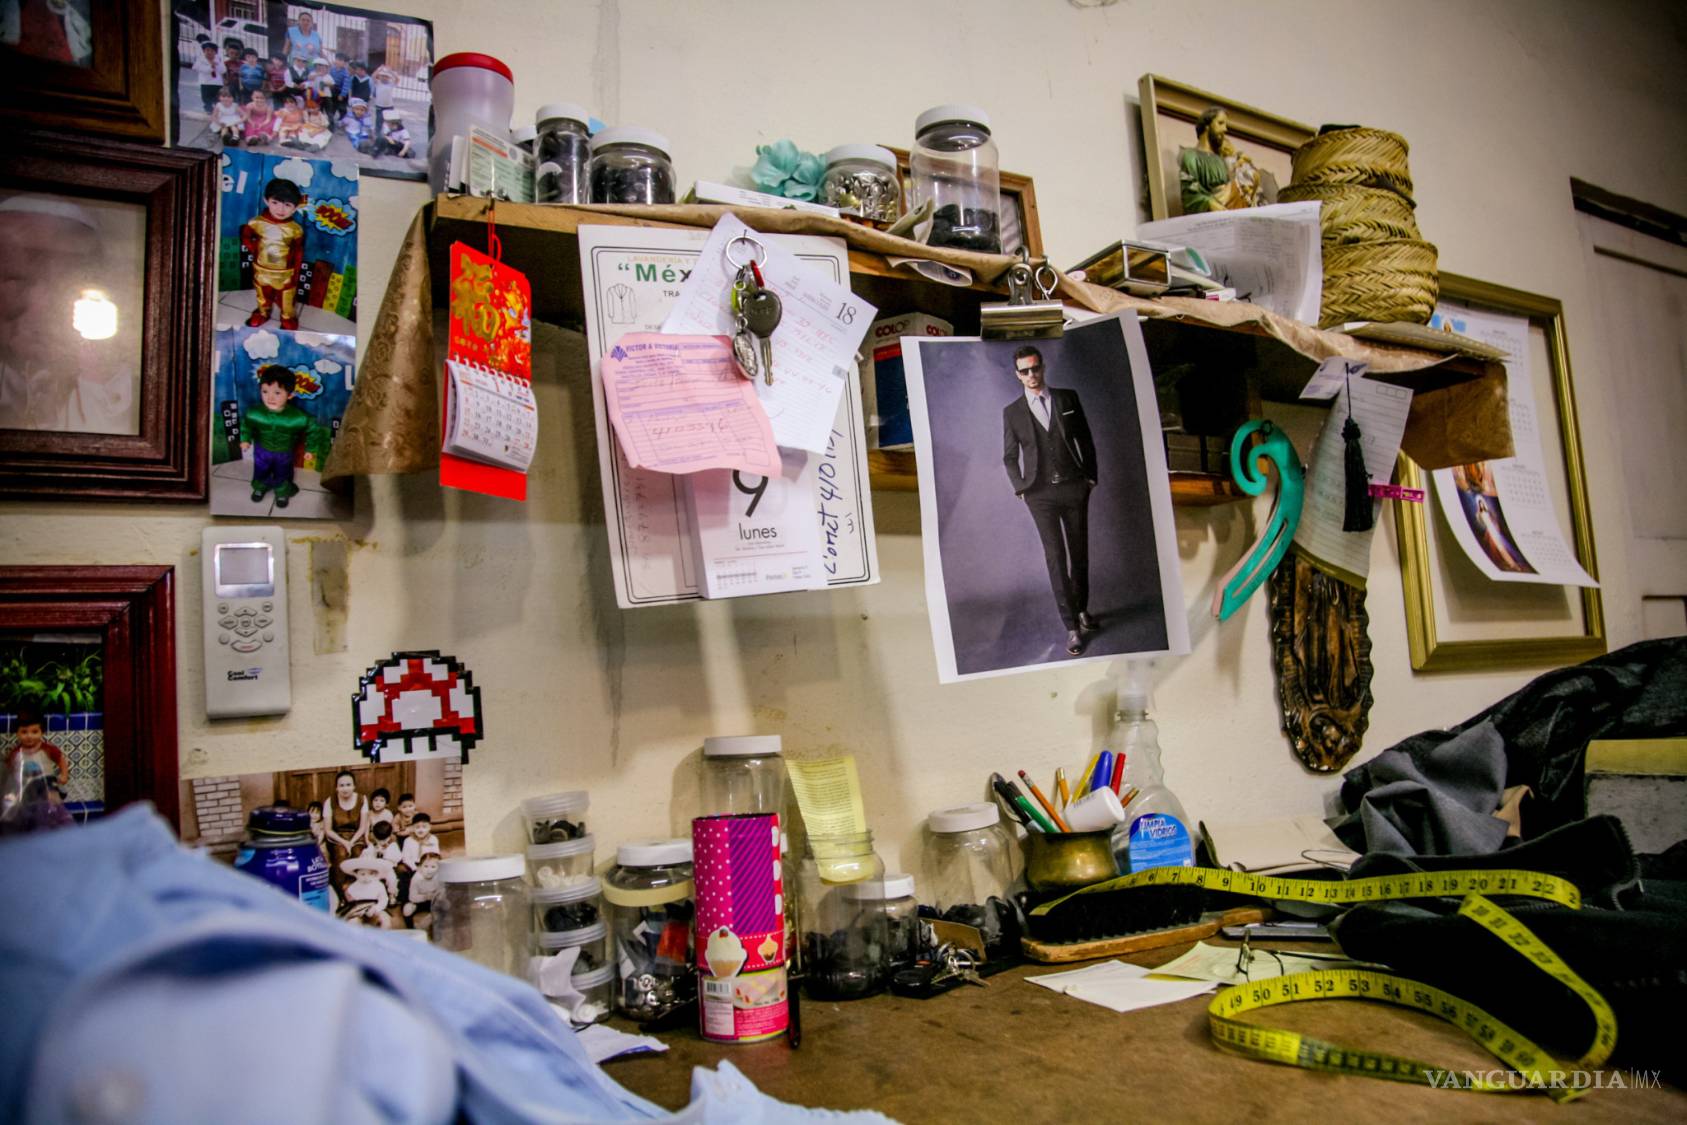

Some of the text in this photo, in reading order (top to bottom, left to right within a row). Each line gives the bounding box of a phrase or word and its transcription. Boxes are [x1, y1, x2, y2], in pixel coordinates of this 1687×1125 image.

[836, 302, 857, 325] 18
[732, 469, 769, 518] 9
[738, 522, 777, 540] lunes
[1171, 872, 1178, 882] 7
[1197, 875, 1204, 885] 8
[1222, 877, 1230, 887] 9
[1249, 880, 1265, 892] 10
[1277, 885, 1290, 896] 11
[1300, 886, 1314, 897] 12
[1324, 888, 1338, 899] 13
[1345, 887, 1355, 898] 14
[1361, 886, 1373, 897] 15
[1379, 884, 1391, 896] 16
[1418, 880, 1433, 892] 18
[1443, 879, 1458, 890] 19
[1468, 878, 1488, 890] 20
[1498, 878, 1517, 890] 21
[1532, 881, 1555, 895] 22
[1253, 988, 1270, 1002] 50
[1282, 983, 1299, 996] 51
[1314, 980, 1334, 993] 52
[1349, 979, 1370, 992] 53
[1383, 983, 1401, 999] 54
[1414, 991, 1433, 1007] 55
